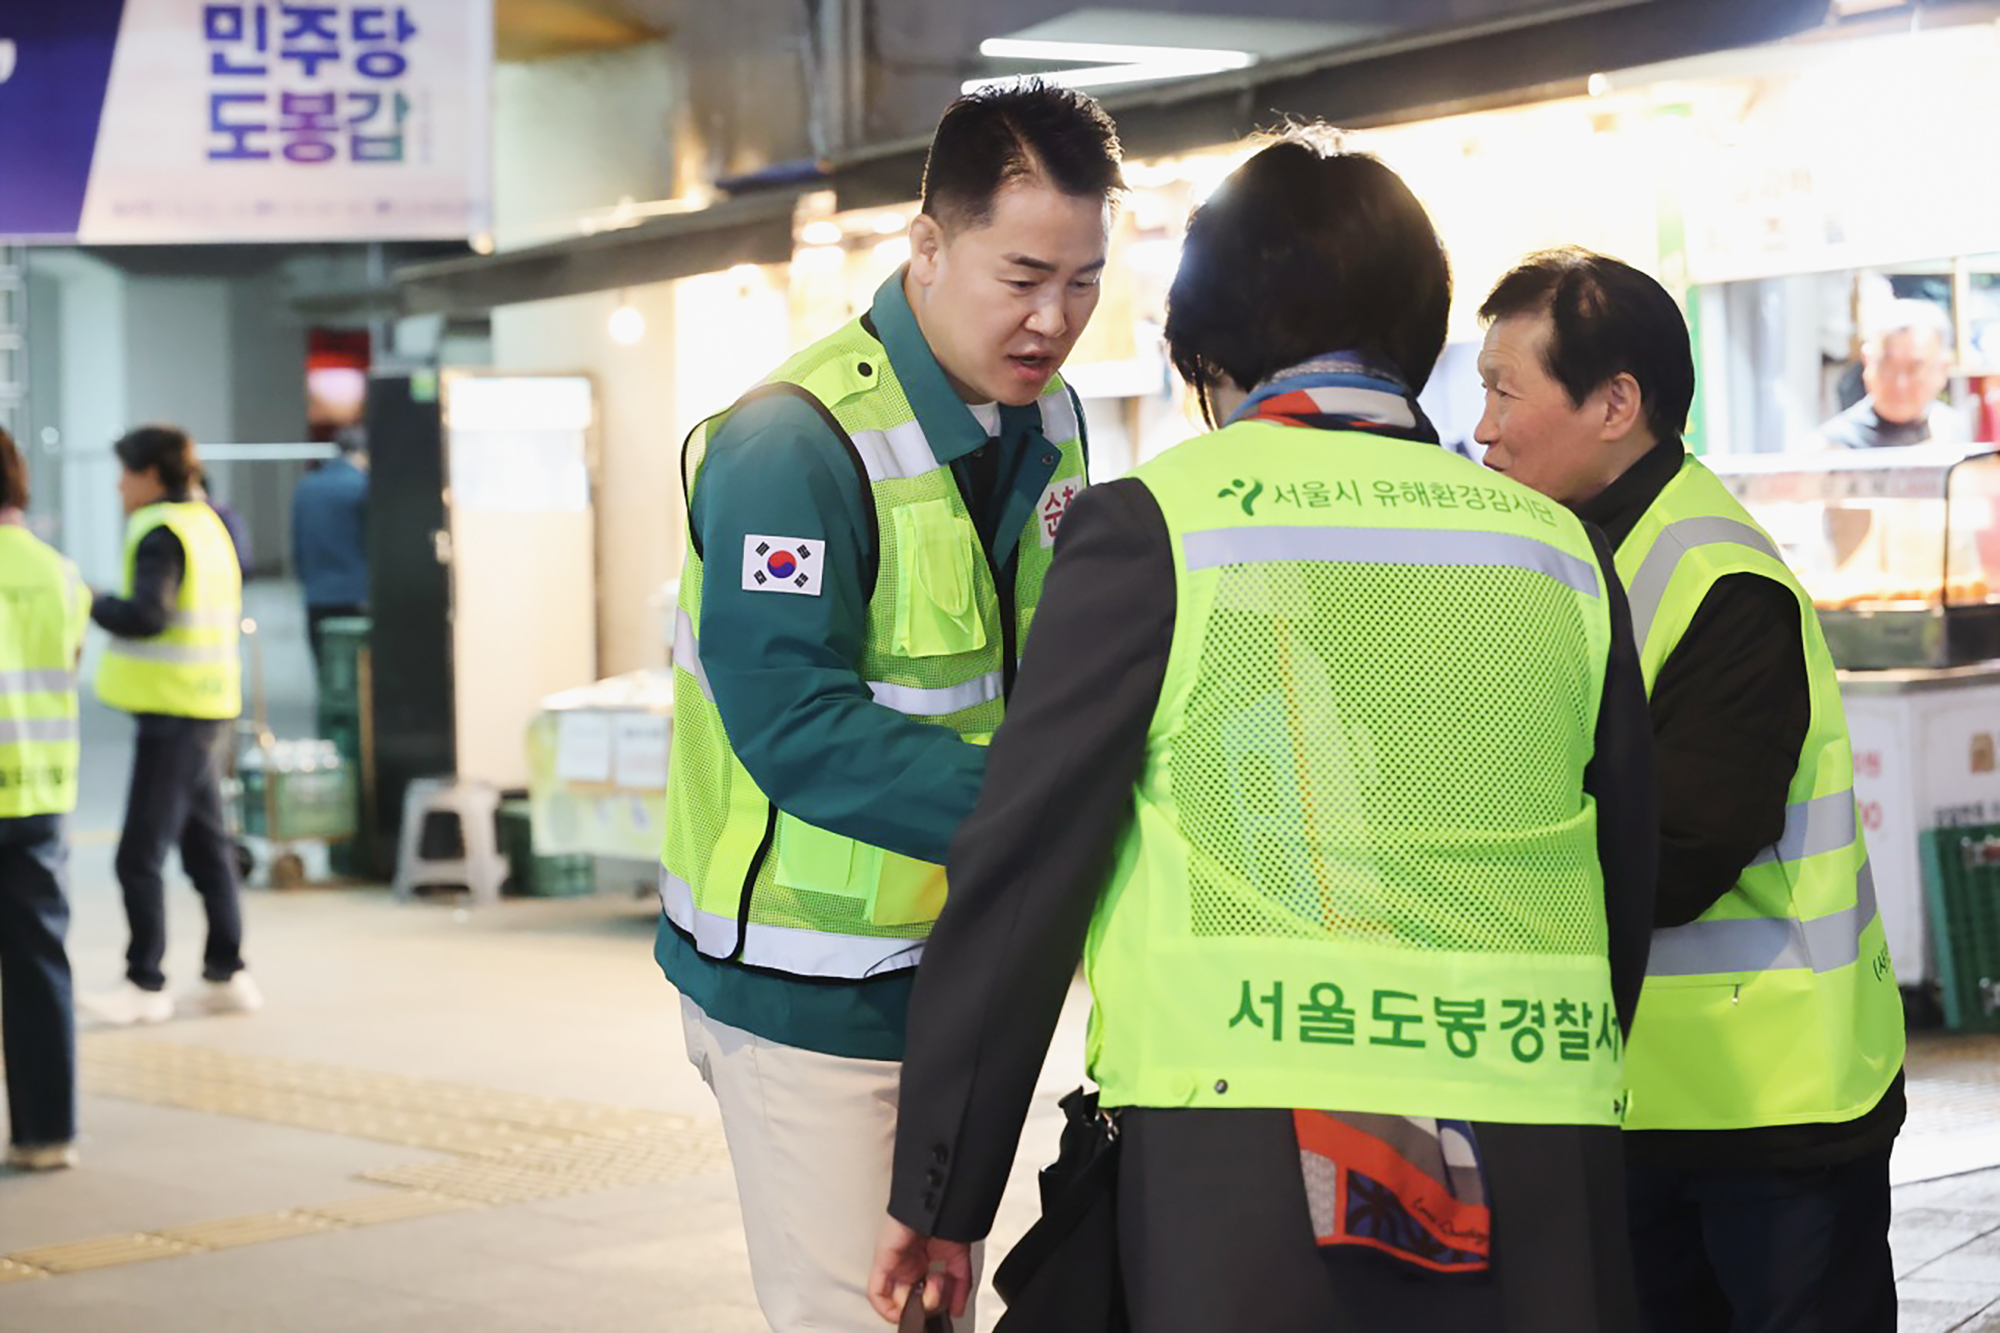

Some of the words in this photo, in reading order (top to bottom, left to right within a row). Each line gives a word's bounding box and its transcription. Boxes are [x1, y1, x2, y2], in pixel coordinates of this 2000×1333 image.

[204, 5, 417, 79] 민주당
[1273, 479, 1363, 509] 서울시
[1371, 479, 1558, 528] 유해환경감시단
[1228, 979, 1619, 1064] 서울도봉경찰서
